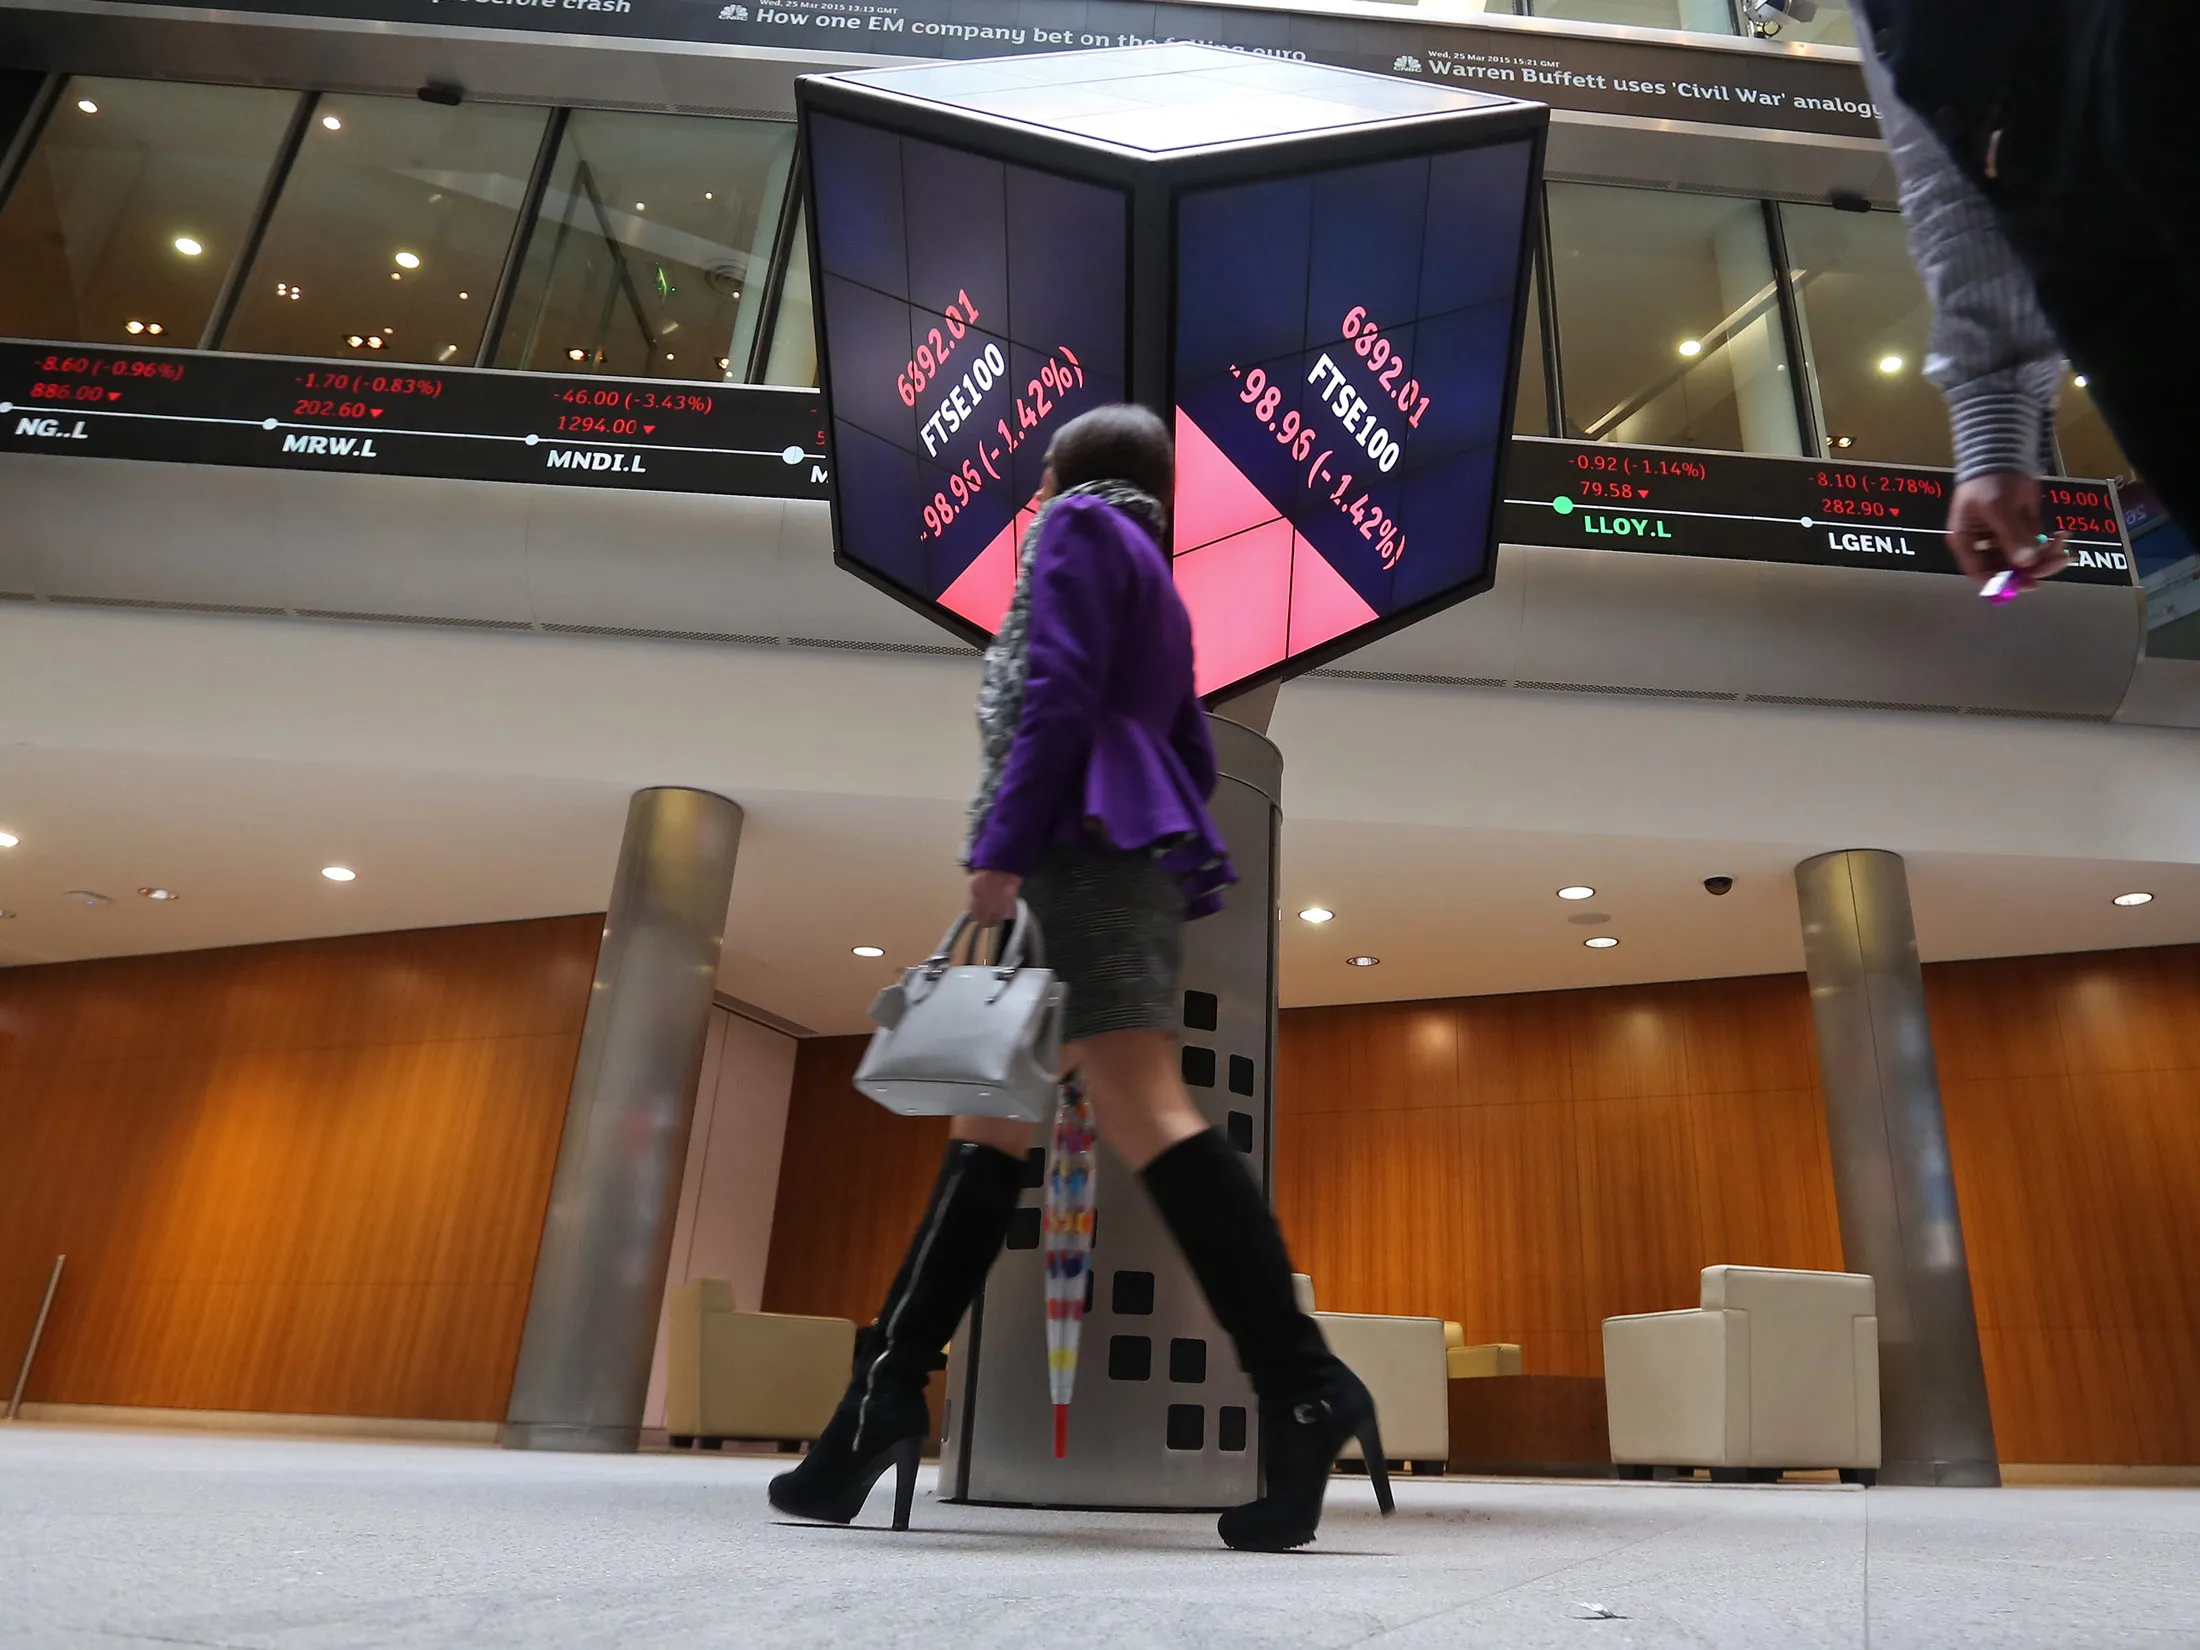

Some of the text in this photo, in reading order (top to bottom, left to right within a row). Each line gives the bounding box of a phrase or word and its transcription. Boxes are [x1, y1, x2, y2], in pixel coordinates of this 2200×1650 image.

[562, 0, 631, 13] crash
[786, 0, 799, 8] 25
[820, 3, 846, 11] 2015
[848, 5, 875, 13] 13:13
[756, 8, 809, 26] How
[815, 14, 861, 30] one
[868, 16, 904, 32] EM
[911, 20, 1026, 44] company
[1033, 28, 1073, 44] bet
[1080, 34, 1110, 47] on
[1428, 50, 1560, 68] Wed, 25 Mar 2015 15:21 GMT
[1428, 60, 1516, 82] Warren
[1522, 68, 1607, 90] Buffett
[1613, 79, 1666, 95] uses
[1672, 82, 1730, 101] 'Civil
[1734, 87, 1786, 106] War'
[897, 288, 980, 408] 6892.01
[34, 356, 184, 382] -8.60 (-0.96%)
[1342, 306, 1431, 428] 6892.01
[30, 382, 105, 400] 886.00
[295, 372, 443, 399] -1.70 (-0.83%)
[294, 399, 366, 418] 202.60
[553, 388, 713, 415] -46.00 (-3.43%)
[920, 343, 1006, 458] FTSE100
[1308, 352, 1400, 473] FTSE100
[978, 346, 1085, 480] (-1.42%)
[14, 418, 89, 439] NG..L
[557, 416, 638, 435] 1294.00
[282, 434, 378, 458] MRW.L
[546, 449, 646, 473] MNDI.L
[1568, 455, 1706, 480] -0.92 (-1.14%)
[1580, 481, 1633, 499] 79.58
[1808, 472, 1942, 498] -8.10 (-2.78%)
[1308, 450, 1407, 570] (-1.42%)
[1822, 499, 1885, 518] 282.90
[1584, 515, 1672, 538] LLOY.L
[2056, 516, 2116, 534] 1254.0
[1828, 532, 1916, 556] LGEN.L
